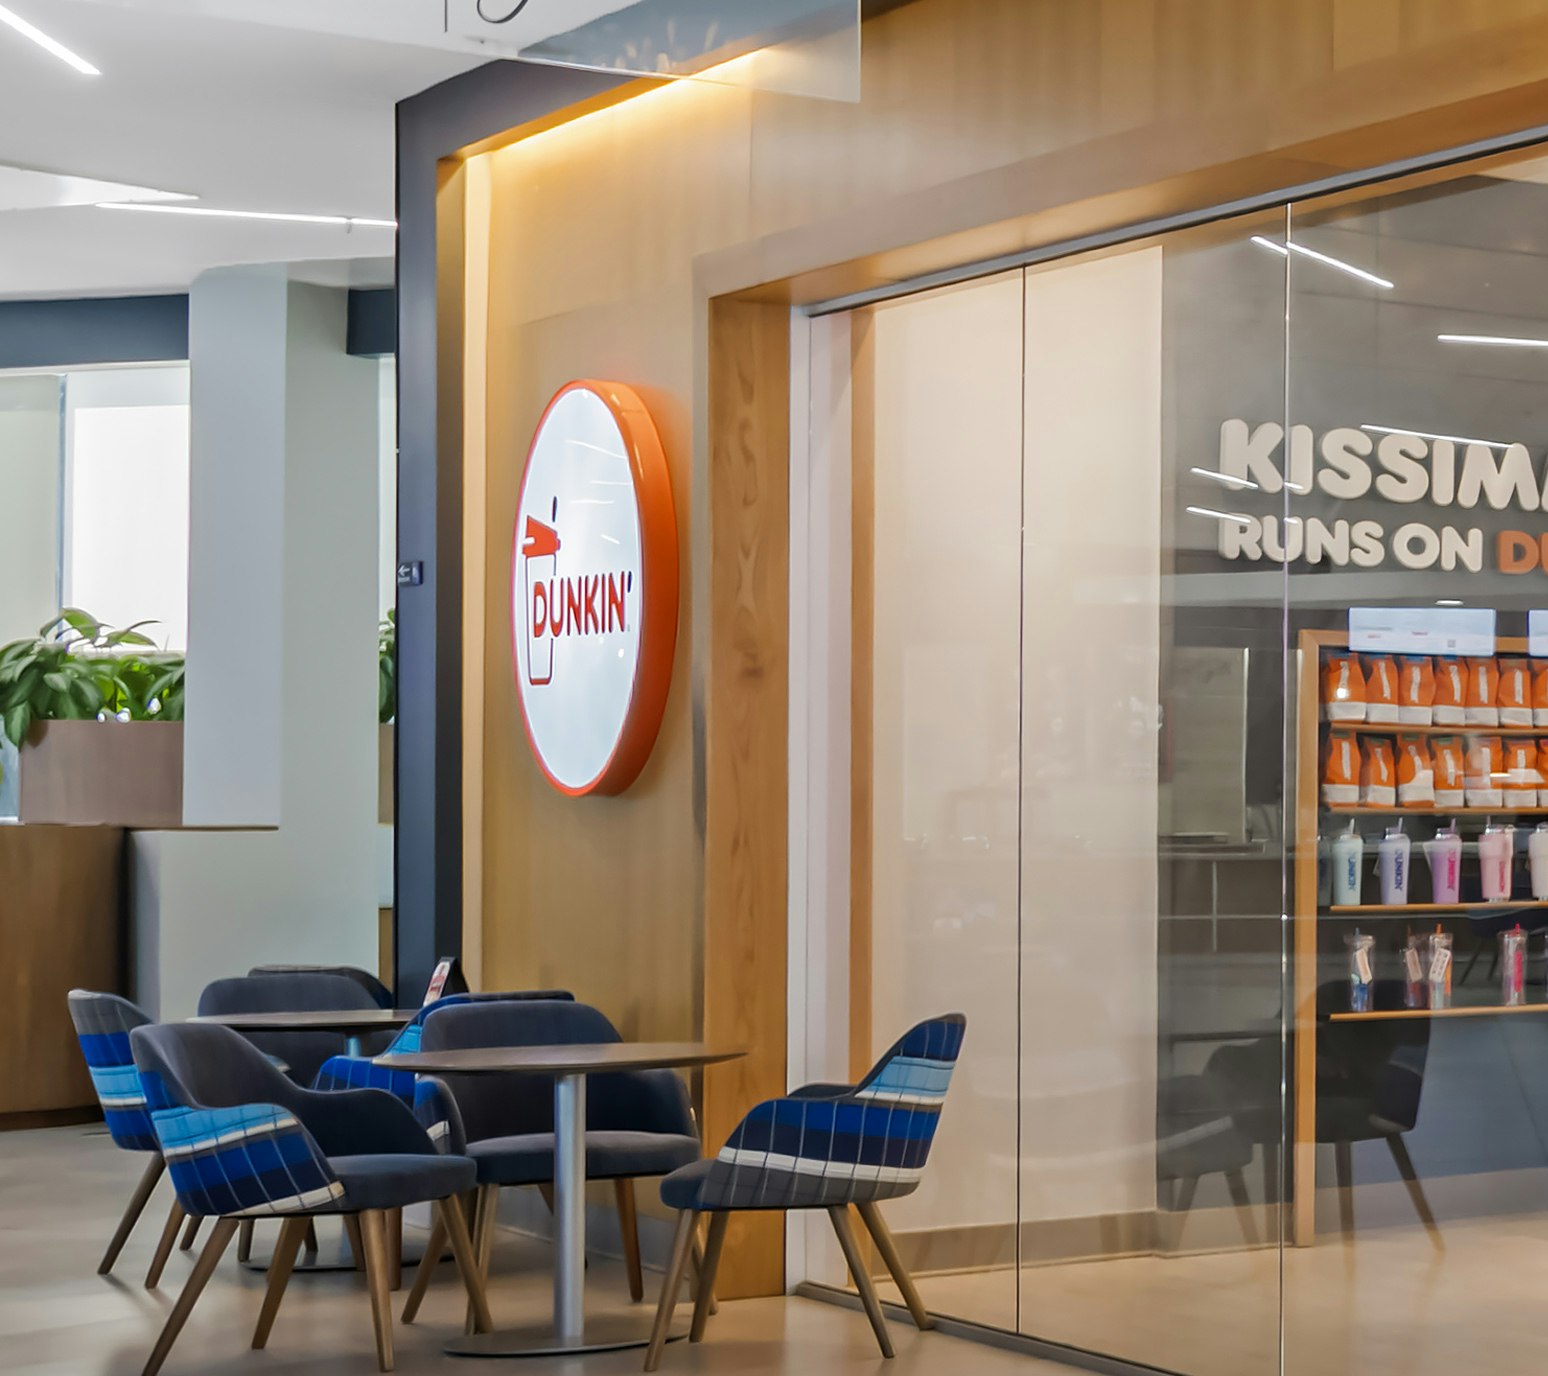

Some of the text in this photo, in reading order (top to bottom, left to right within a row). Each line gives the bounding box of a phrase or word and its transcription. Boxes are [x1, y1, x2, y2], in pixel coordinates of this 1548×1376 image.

[1218, 513, 1386, 569] RUNS
[1392, 522, 1483, 574] ON
[533, 570, 633, 639] DUNKIN'
